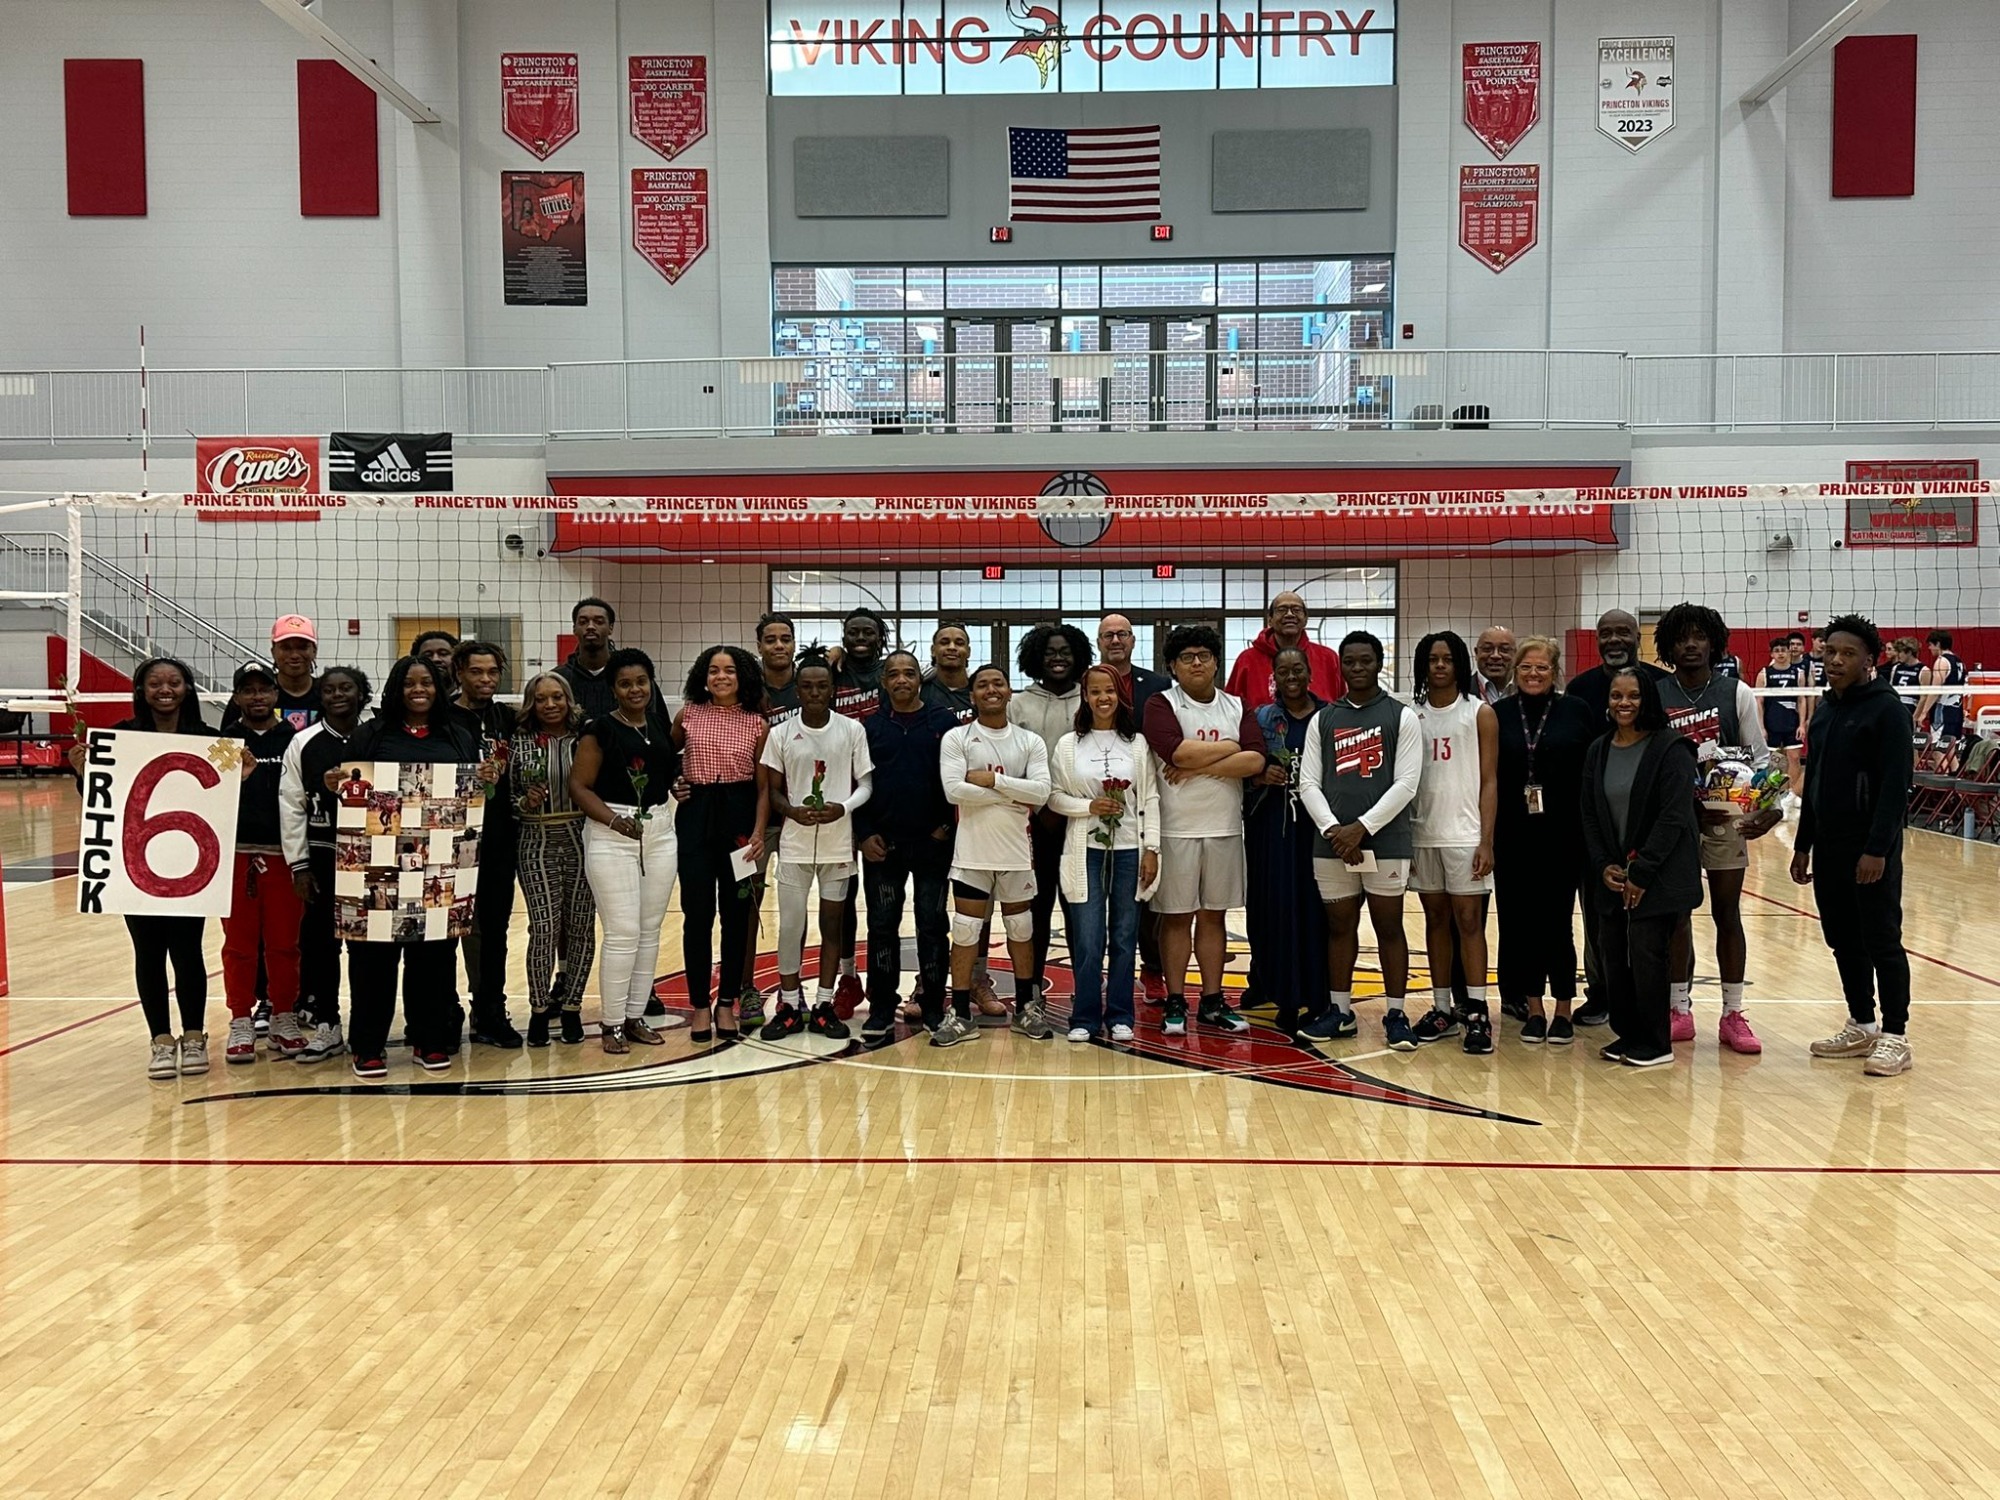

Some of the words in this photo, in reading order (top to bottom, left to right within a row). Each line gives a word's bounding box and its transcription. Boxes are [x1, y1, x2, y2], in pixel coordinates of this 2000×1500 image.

[790, 16, 990, 65] VIKING
[1083, 9, 1376, 62] COUNTRY
[1474, 45, 1528, 56] PRINCETON
[1602, 47, 1671, 61] EXCELLENCE
[513, 57, 566, 66] PRINCETON
[641, 59, 693, 68] PRINCETON
[1478, 56, 1524, 64] BASKETBALL
[514, 67, 565, 75] VOLLEYBALL
[1494, 68, 1530, 77] CAREER
[1486, 77, 1518, 85] POINTS
[1602, 100, 1641, 109] PRINCETON
[1642, 99, 1670, 108] VIKINGS
[1617, 119, 1653, 132] 2023
[643, 171, 696, 181] PRINCETON
[1473, 167, 1527, 177] PRINCETON
[642, 195, 659, 203] 1000
[661, 195, 698, 203] CAREER
[540, 197, 573, 216] VIKINGS
[654, 203, 686, 211] POINTS
[1155, 226, 1170, 239] EXIT
[245, 451, 280, 461] Raising
[212, 449, 308, 493] Cane's
[361, 467, 421, 483] adidas
[1855, 465, 1968, 480] Princeton
[1575, 487, 1673, 501] PRINCETON
[1678, 485, 1748, 499] VIKINGS
[1819, 482, 1915, 496] PRINCETON
[1921, 480, 1990, 494] VIKINGS
[184, 494, 275, 508] PRINCETON
[282, 494, 347, 508] VIKINGS
[414, 496, 507, 510] PRINCETON
[512, 496, 578, 510] VIKINGS
[646, 497, 736, 510] PRINCETON
[742, 497, 808, 510] VIKINGS
[875, 497, 966, 510] PRINCETON
[972, 497, 1037, 510] VIKINGS
[1104, 496, 1196, 509] PRINCETON
[1202, 495, 1268, 508] VIKINGS
[1337, 492, 1430, 507] PRINCETON
[1437, 490, 1505, 504] VIKINGS
[1870, 512, 1956, 528] VIKINGS
[1851, 531, 1887, 539] NATIONAL
[1890, 531, 1915, 539] GUARD
[986, 566, 1002, 578] EXIT
[1157, 565, 1173, 577] EXIT
[1433, 737, 1451, 761] 13
[1360, 750, 1383, 777] P
[352, 784, 360, 795] 6
[80, 731, 116, 914] ERICK
[122, 751, 221, 898] 6
[410, 858, 417, 868] 6
